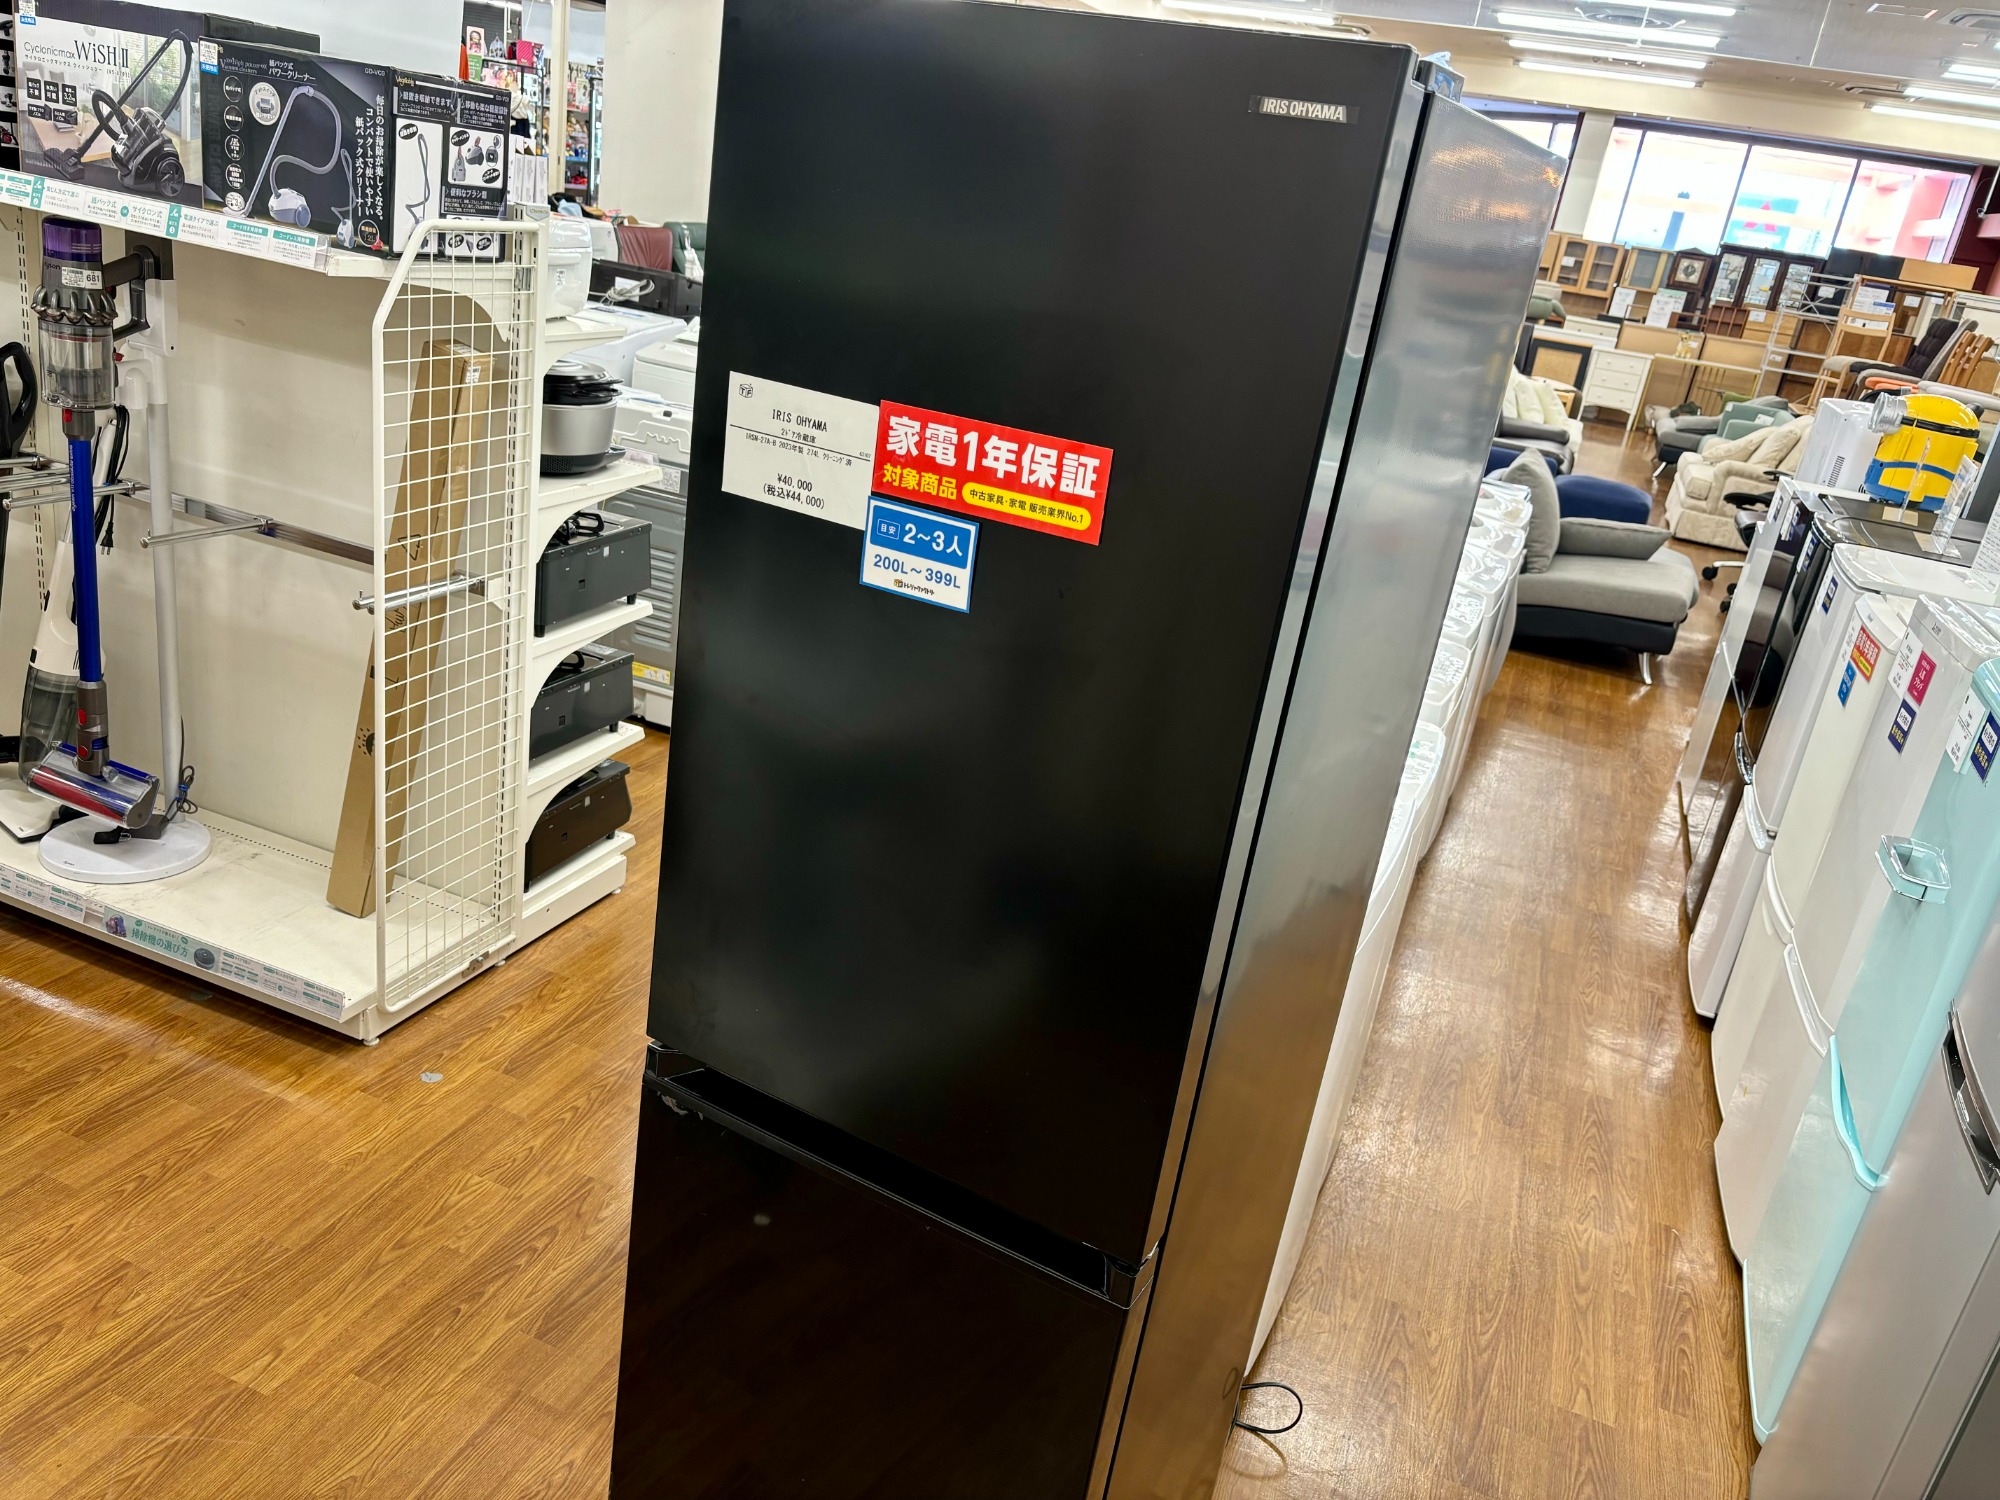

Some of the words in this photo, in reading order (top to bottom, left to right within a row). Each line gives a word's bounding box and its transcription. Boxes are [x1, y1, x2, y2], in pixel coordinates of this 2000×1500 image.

[24, 42, 75, 59] Cyclonicmax
[74, 40, 117, 67] WiSH
[269, 69, 317, 81] パワークリーナー
[1263, 98, 1288, 115] IRIS
[1289, 101, 1344, 120] OHYAMA
[355, 116, 364, 217] 紙パック式クリーナー
[365, 107, 374, 216] コンパクトで使いやすい
[375, 95, 385, 221] 毎日のお掃除が楽しくなる。
[132, 205, 163, 218] サイクロン式
[86, 274, 100, 283] 681
[772, 408, 792, 423] IRIS
[796, 415, 827, 432] OHYAMA
[778, 441, 804, 455] 2023年製
[886, 415, 1101, 498] 家電1年保証
[882, 463, 957, 500] 対象商品
[881, 523, 897, 535] 目安
[131, 928, 189, 957] 掃除機の選び方
